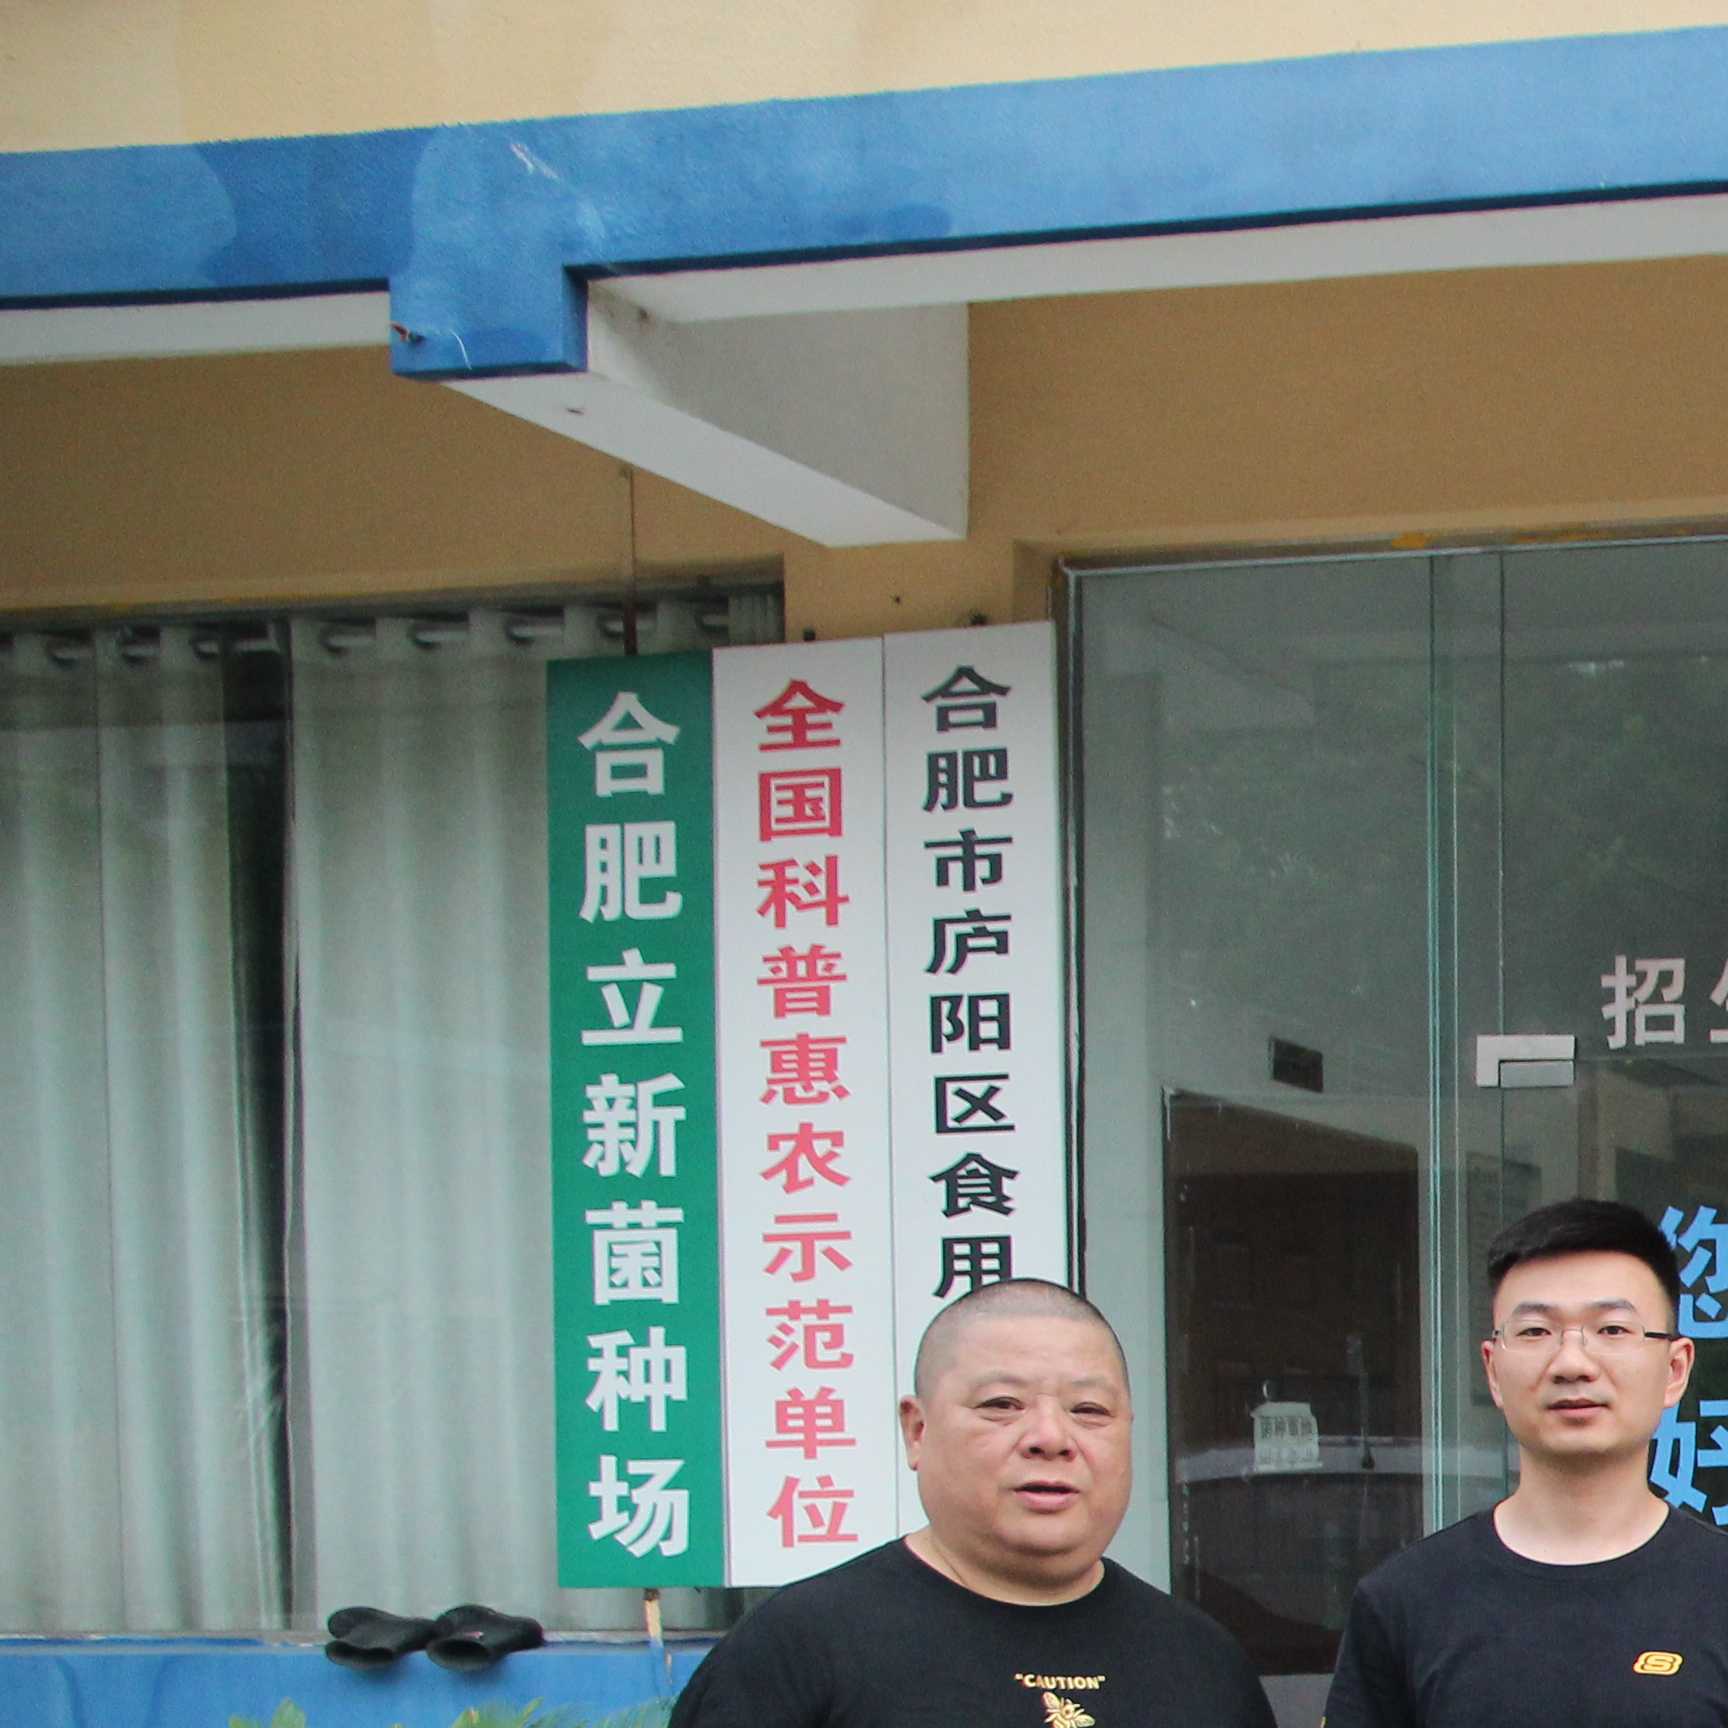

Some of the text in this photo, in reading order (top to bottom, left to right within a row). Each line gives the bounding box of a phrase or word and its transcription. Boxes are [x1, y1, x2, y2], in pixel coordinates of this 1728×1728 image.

[578, 691, 690, 1558] 合肥立新菌种场
[753, 678, 859, 1549] 全国科普惠农示范单位
[921, 665, 1021, 1299] 合肥市庐阳区食用
